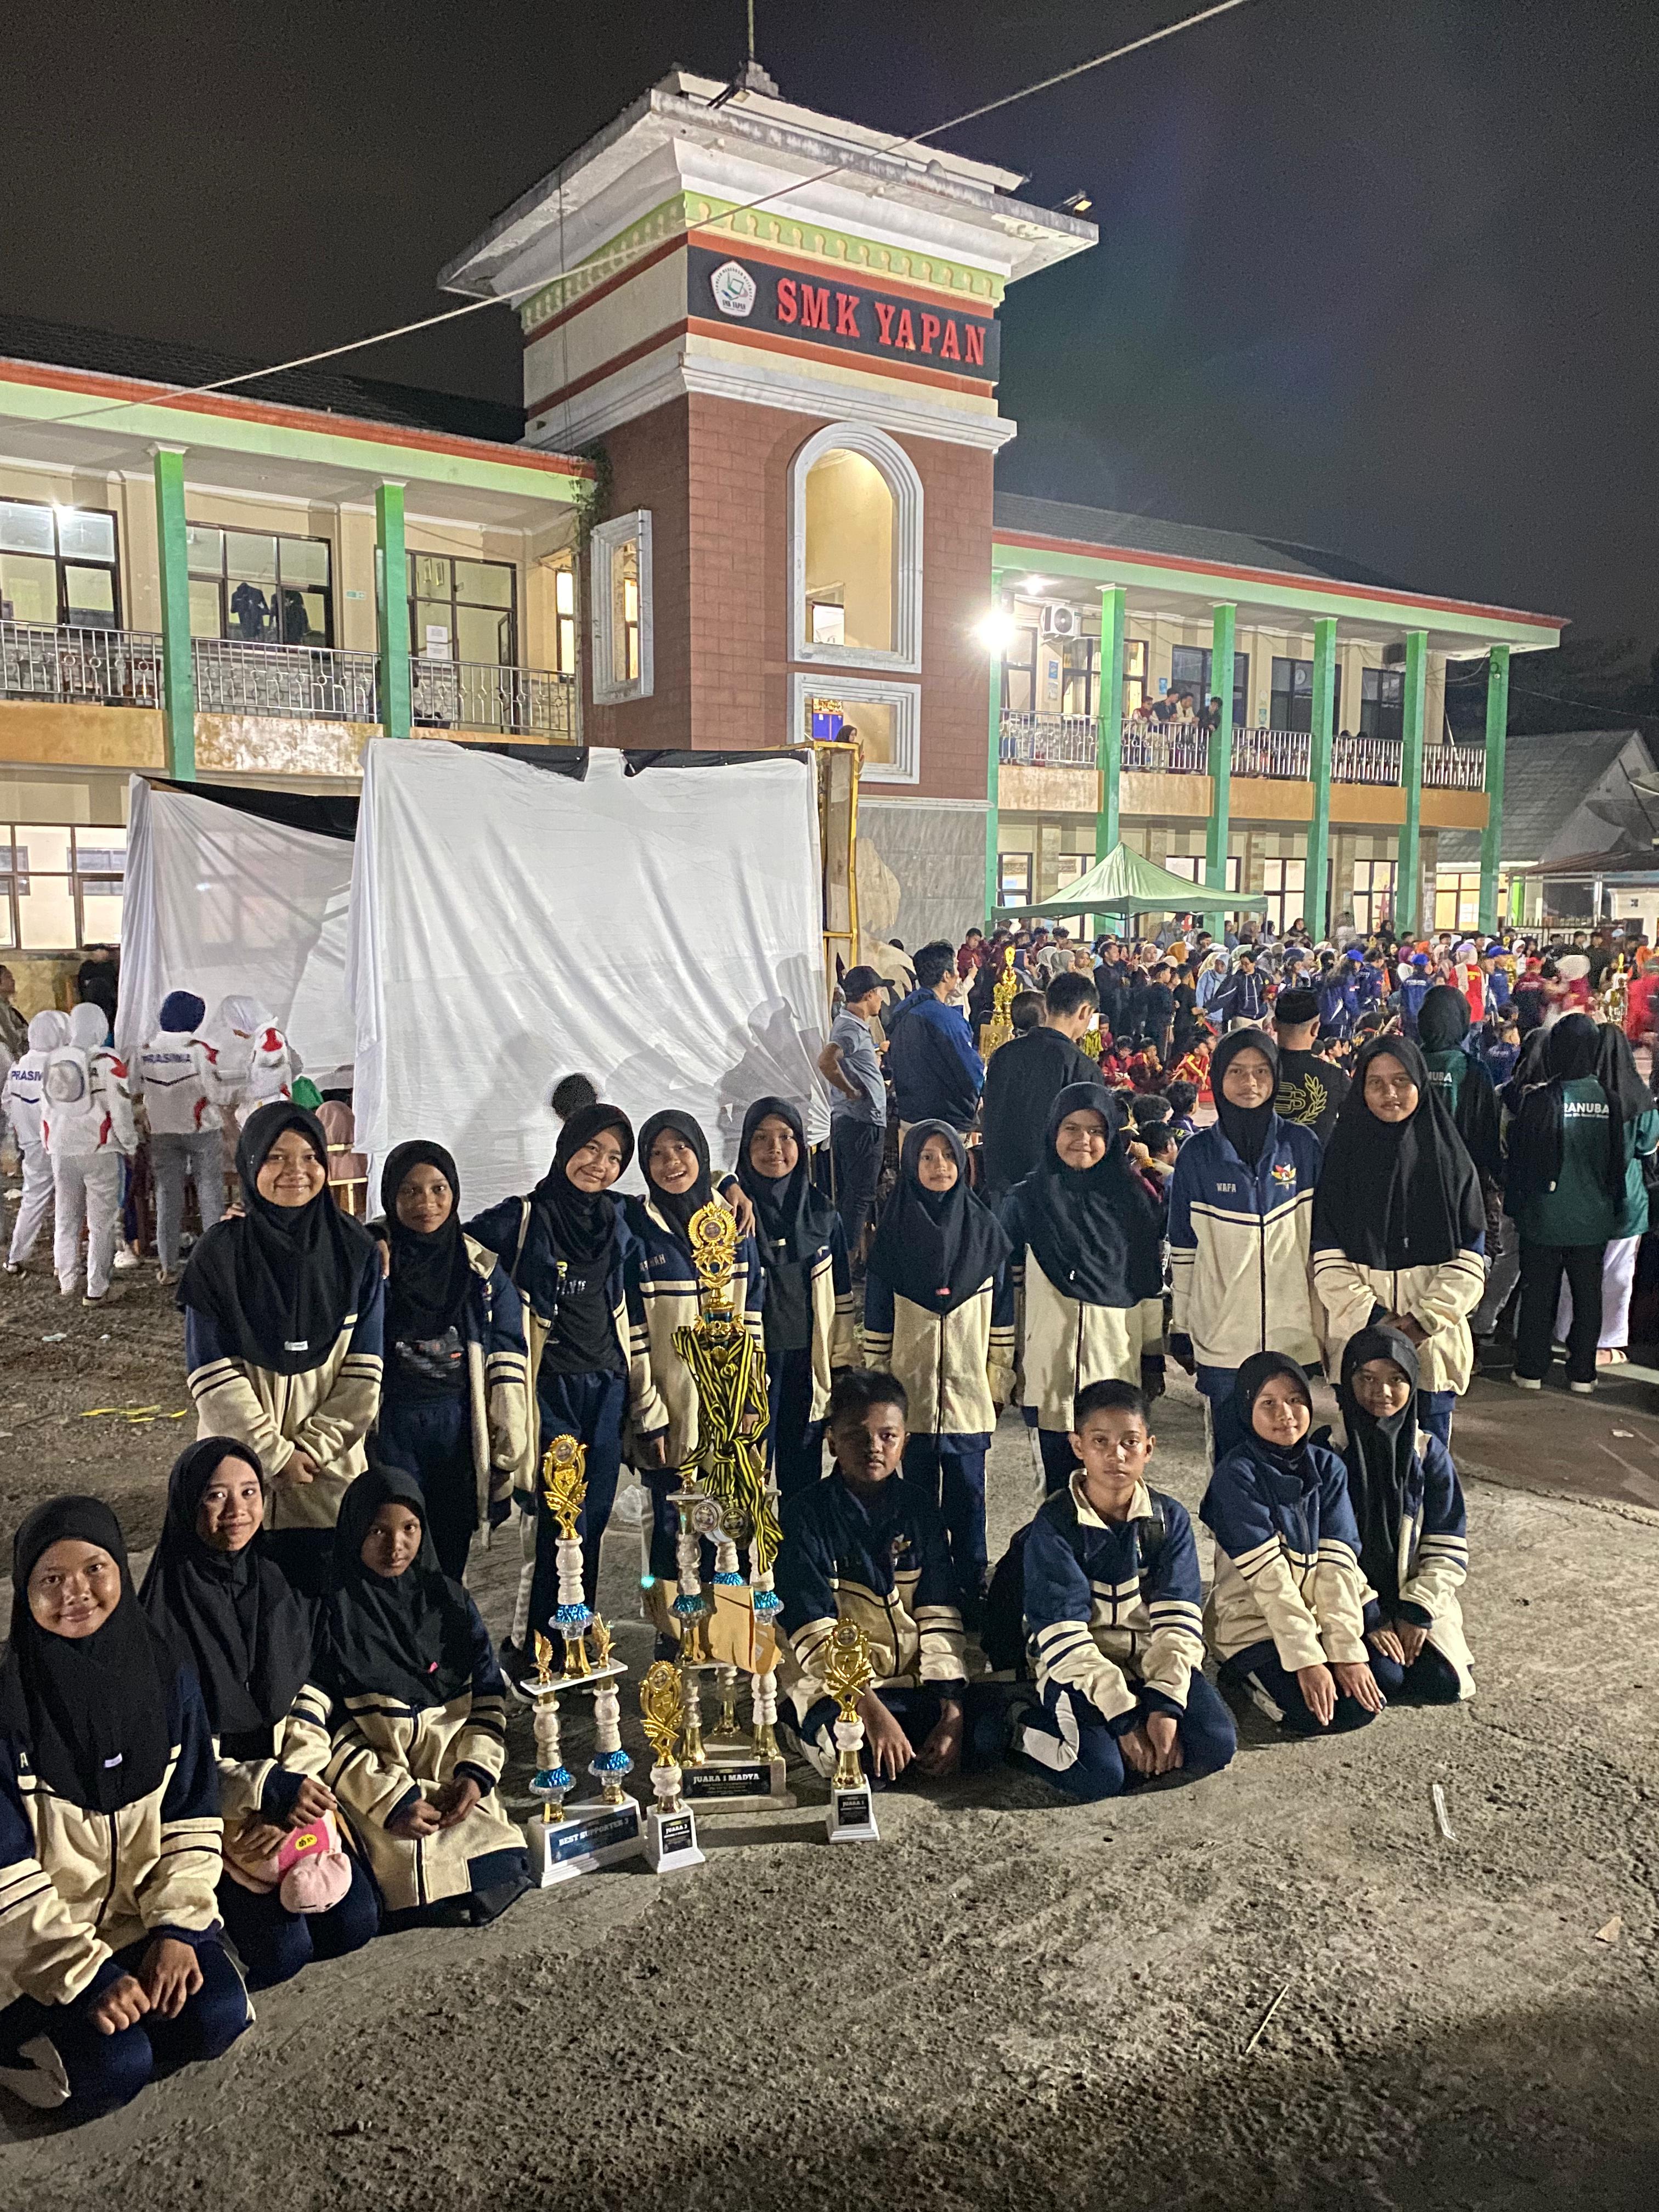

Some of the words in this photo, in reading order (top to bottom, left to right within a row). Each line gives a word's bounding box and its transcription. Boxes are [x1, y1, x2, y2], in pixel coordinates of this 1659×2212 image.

[777, 278, 860, 338] SMK
[874, 301, 986, 366] YAPAN
[1216, 1182, 1237, 1193] WAFA
[693, 1775, 721, 1785] JUARA
[729, 1773, 760, 1781] MADYA
[558, 1833, 579, 1847] BEST
[579, 1819, 624, 1839] SUPPORTER
[665, 1825, 684, 1835] JUARA
